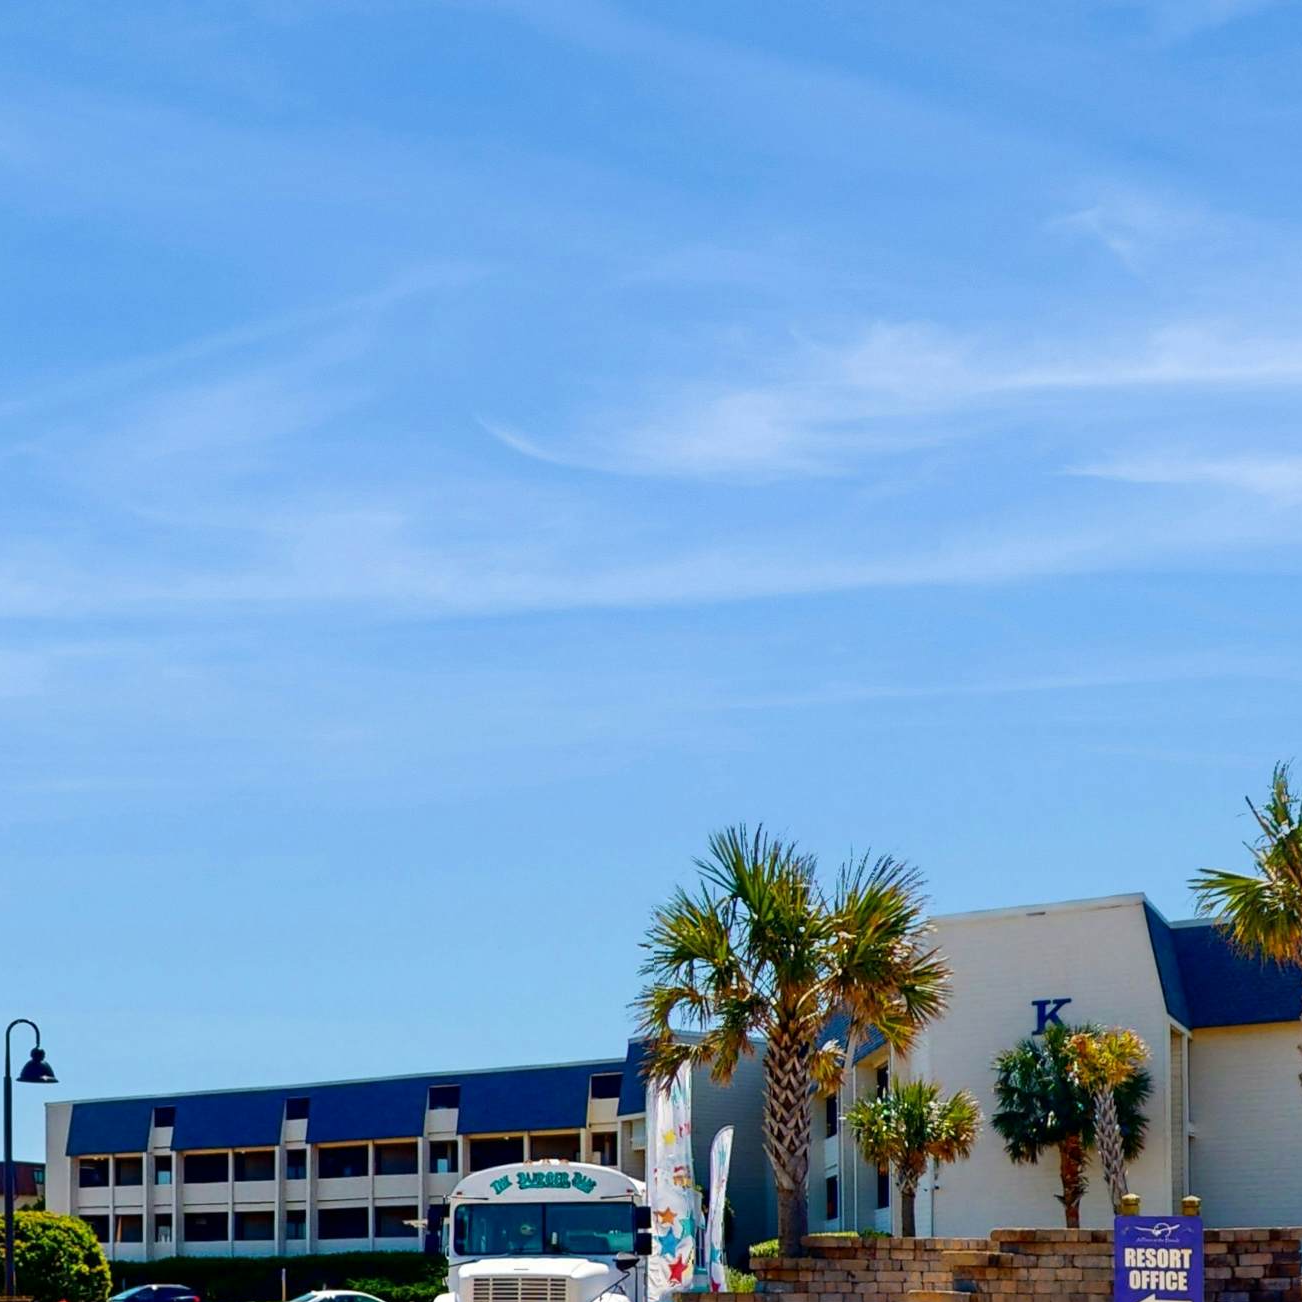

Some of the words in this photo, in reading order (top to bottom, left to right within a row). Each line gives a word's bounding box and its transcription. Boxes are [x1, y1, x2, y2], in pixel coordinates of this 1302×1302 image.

[1032, 998, 1071, 1036] K
[516, 1171, 571, 1190] BURGER
[1124, 1247, 1193, 1269] RESORT
[1129, 1269, 1188, 1291] OFFICE
